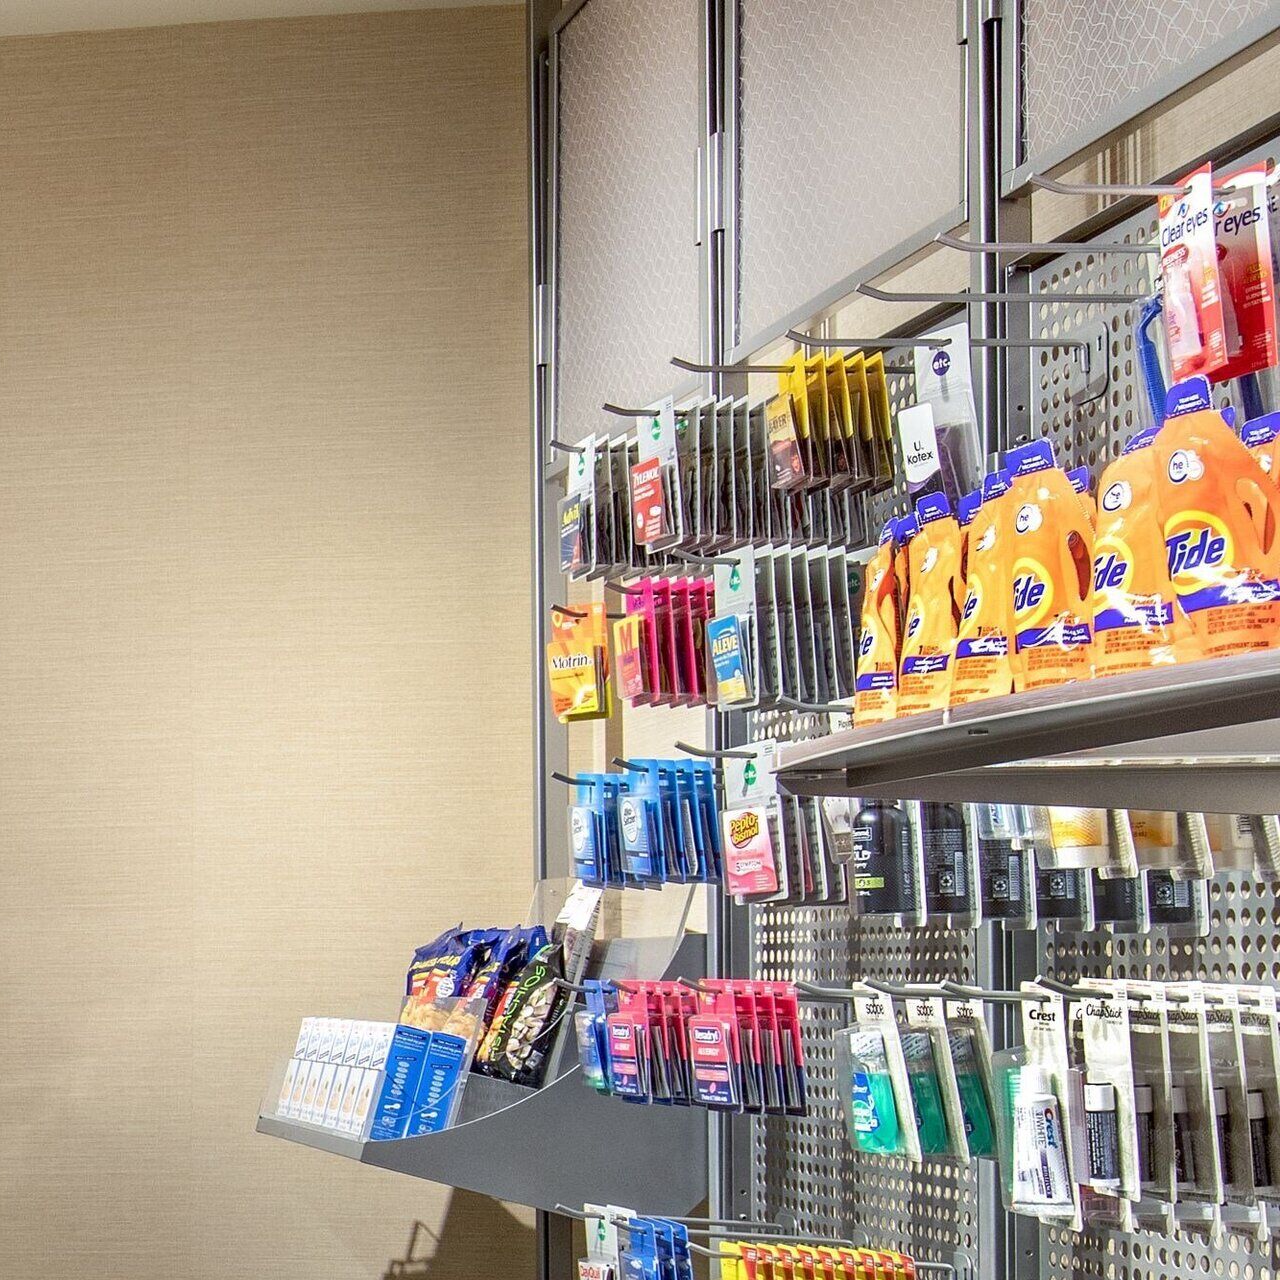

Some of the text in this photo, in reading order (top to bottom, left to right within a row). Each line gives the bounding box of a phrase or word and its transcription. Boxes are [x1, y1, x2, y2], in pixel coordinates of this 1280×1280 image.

[1162, 220, 1184, 247] Clear
[1186, 208, 1208, 236] eyes
[1224, 207, 1261, 235] eyes
[1173, 461, 1184, 470] he
[633, 467, 660, 487] TYLENOL
[1166, 530, 1225, 574] Tide
[712, 636, 738, 656] ALEVE
[551, 654, 588, 669] Motrin
[730, 814, 758, 834] Pepto-
[733, 825, 759, 846] Bismol
[1029, 1009, 1056, 1022] Crest
[1086, 1003, 1122, 1020] ChapStick
[1044, 1107, 1058, 1149] Crest
